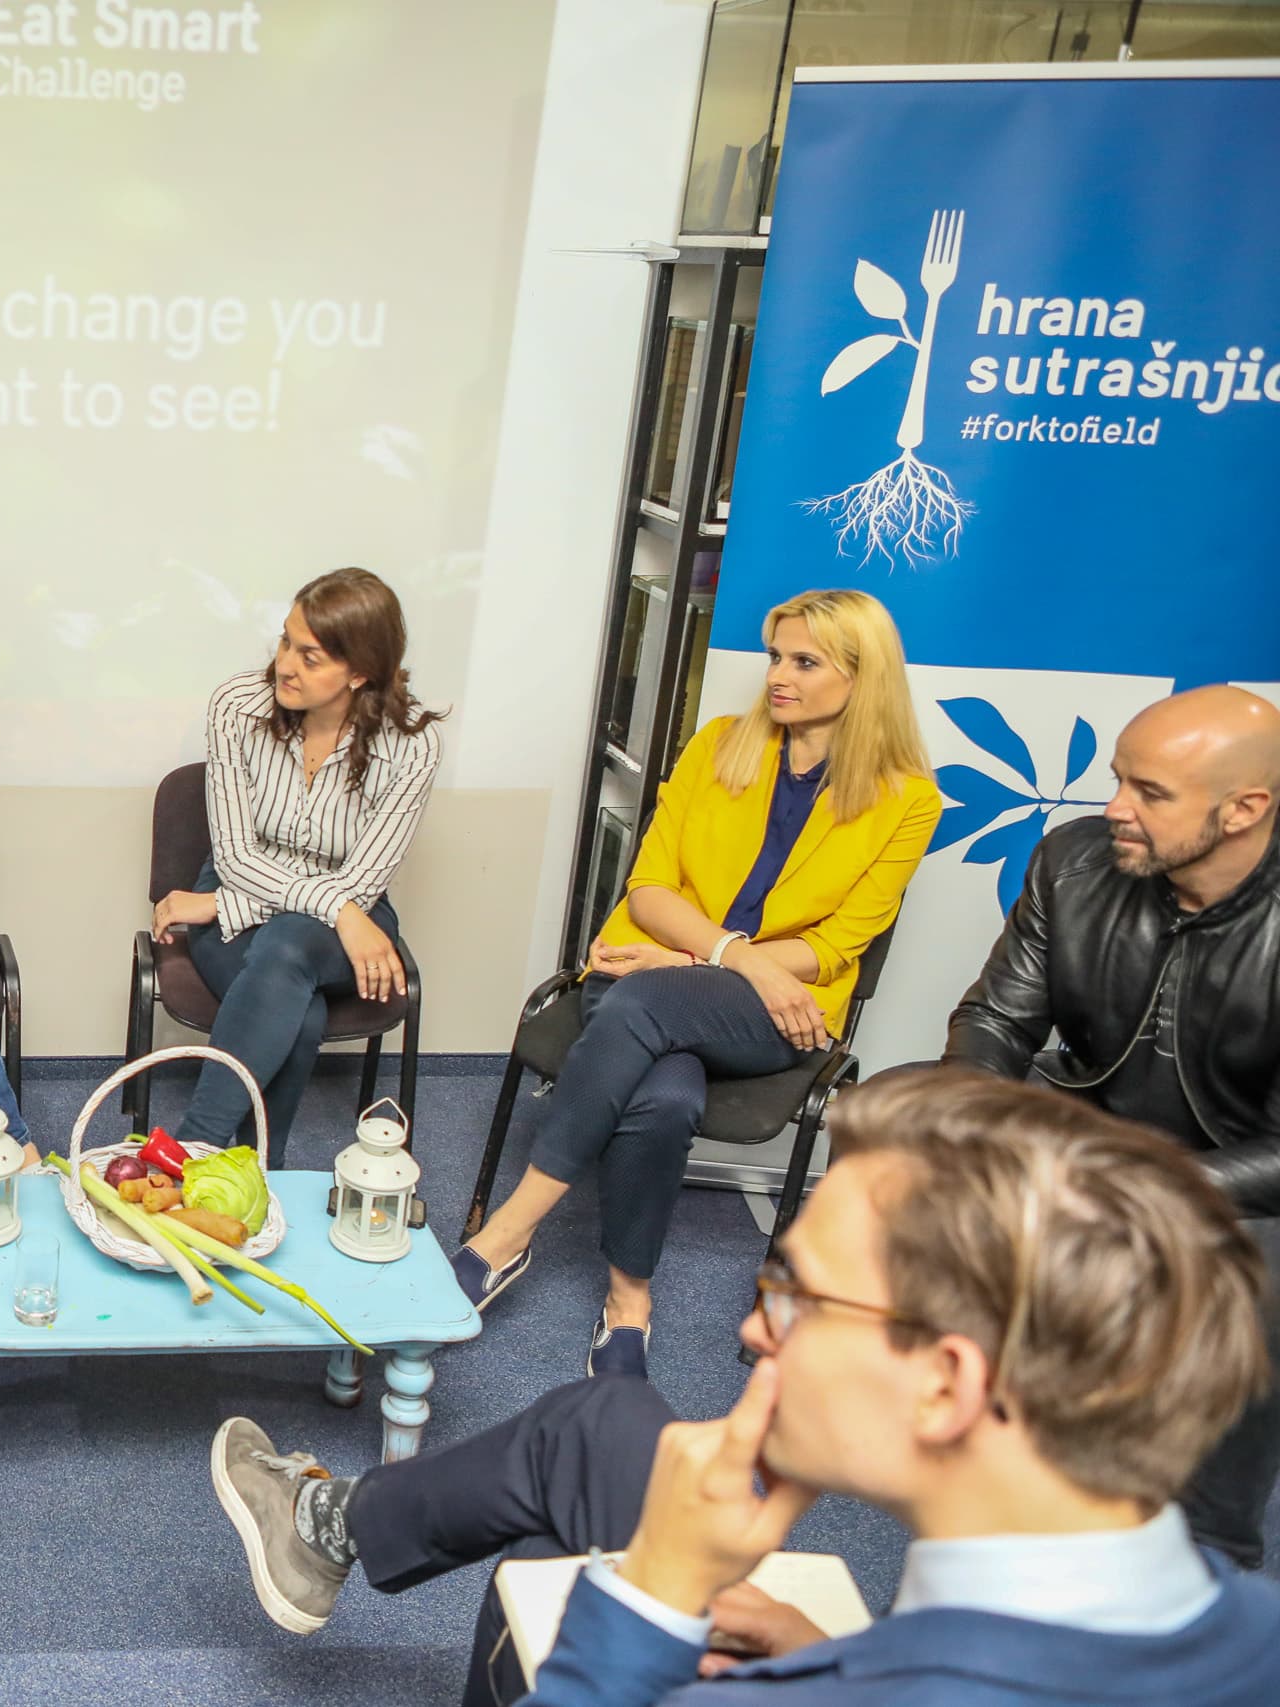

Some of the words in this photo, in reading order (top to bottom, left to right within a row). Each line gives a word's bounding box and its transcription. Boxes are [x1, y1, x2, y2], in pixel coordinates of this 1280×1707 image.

[94, 0, 261, 54] Smart
[2, 274, 248, 361] change
[269, 297, 387, 362] you
[977, 283, 1144, 337] hrana
[60, 368, 125, 428] to
[144, 368, 282, 432] see!
[961, 413, 1160, 445] #forktofield
